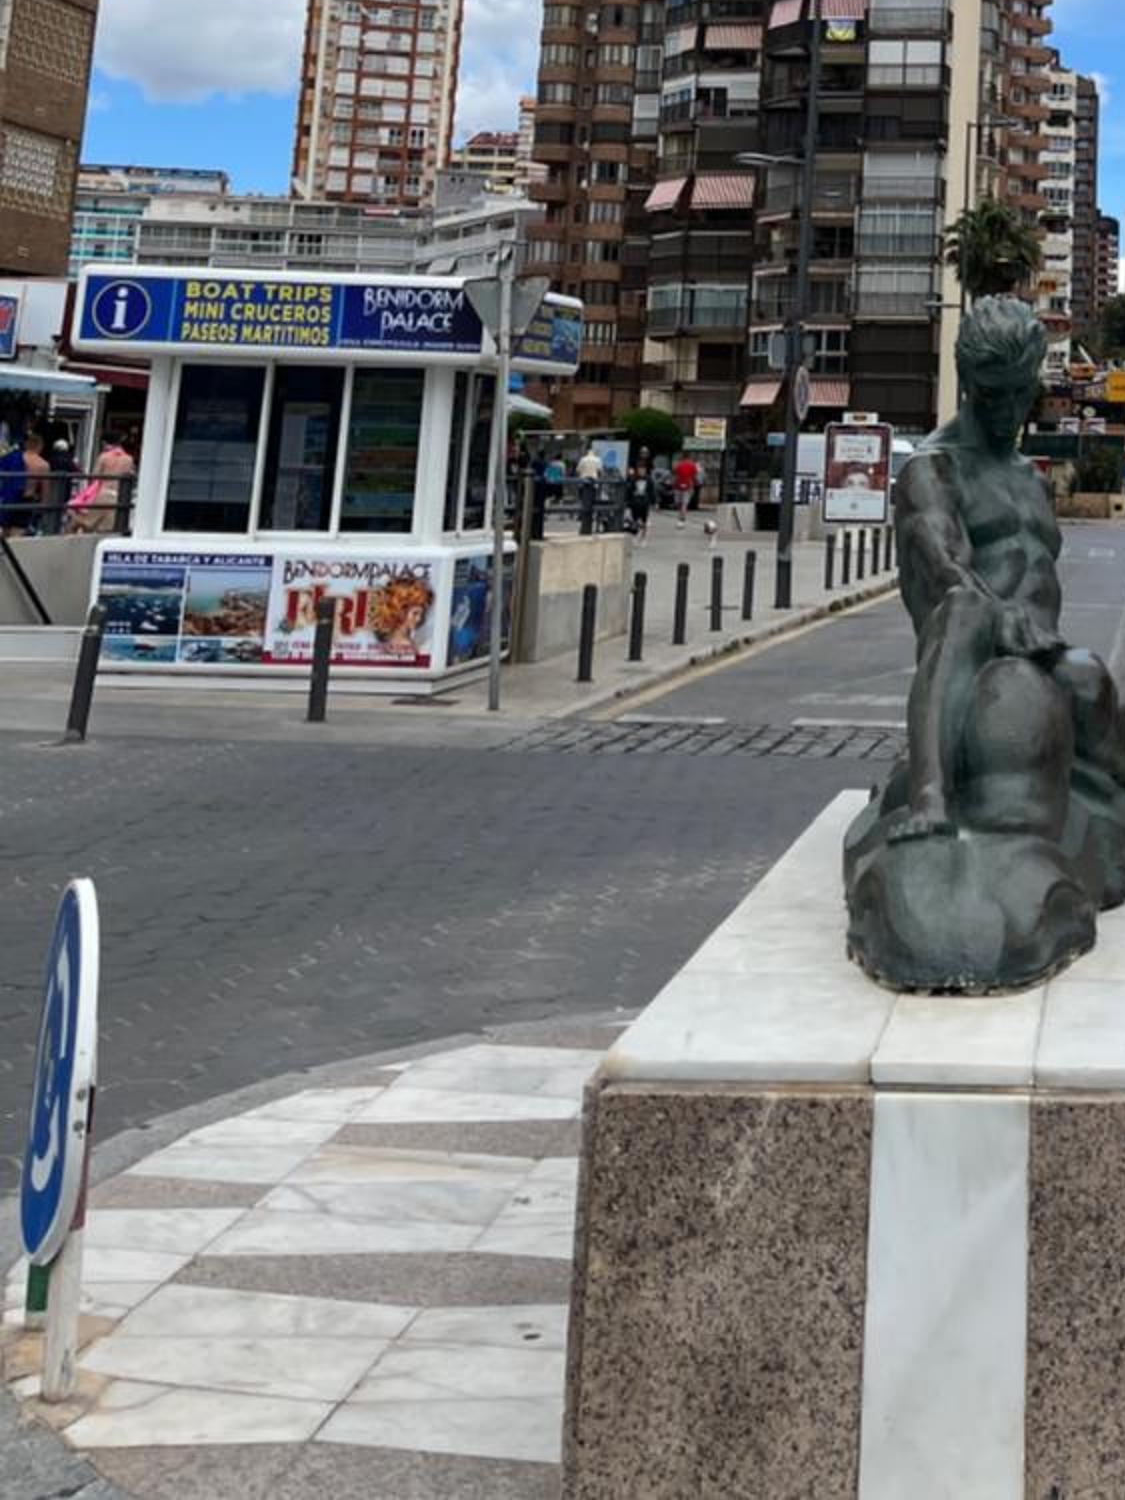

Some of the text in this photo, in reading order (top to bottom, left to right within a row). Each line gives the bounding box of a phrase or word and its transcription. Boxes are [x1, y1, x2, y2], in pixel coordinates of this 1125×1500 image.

[186, 282, 333, 302] BOAT TRIPS
[363, 288, 464, 316] BENIDORM
[184, 301, 331, 323] MINI CRUCEROS
[181, 323, 237, 341] PASEOS
[241, 325, 330, 345] MARTITIMOS
[380, 311, 453, 341] PALACE
[108, 553, 131, 563] ISLA
[134, 554, 148, 564] DE
[151, 555, 200, 564] TABARCA
[213, 556, 265, 566] ALICANTE
